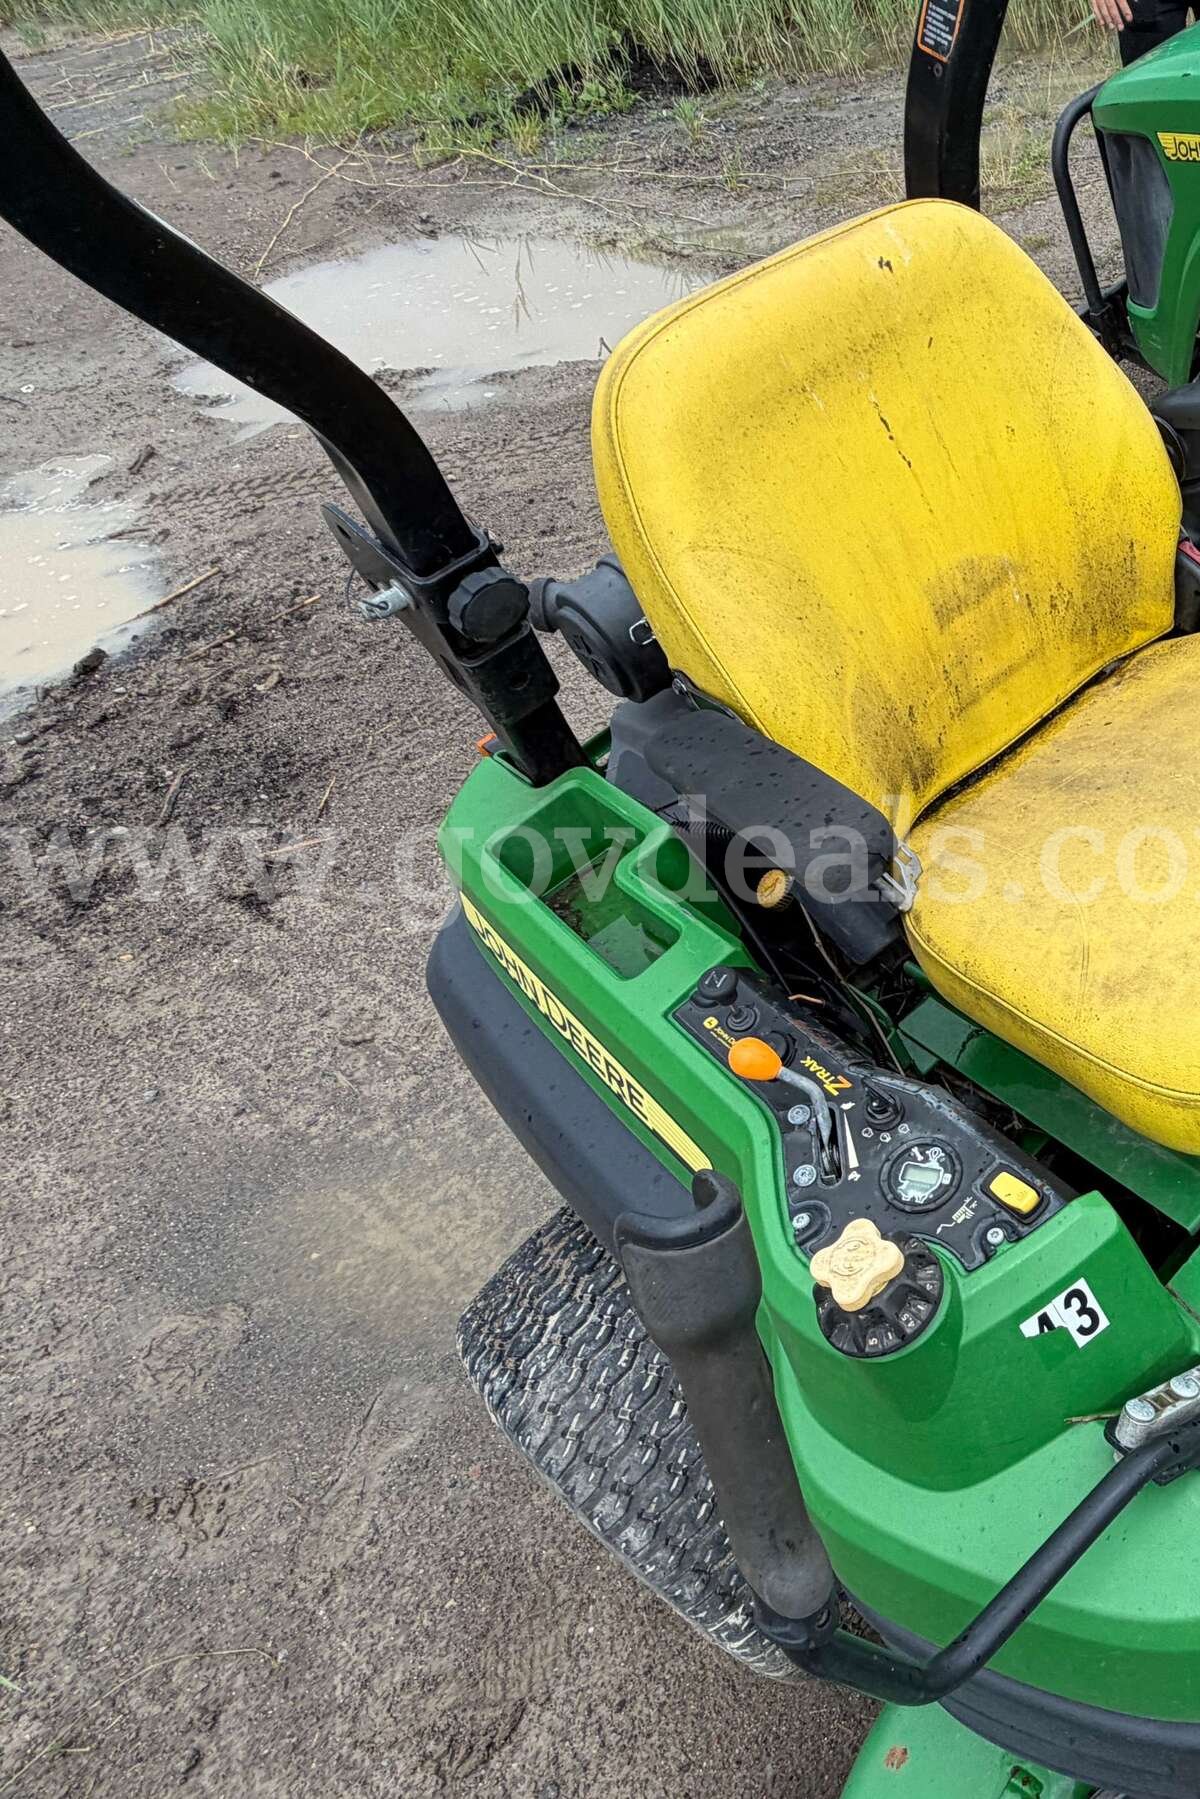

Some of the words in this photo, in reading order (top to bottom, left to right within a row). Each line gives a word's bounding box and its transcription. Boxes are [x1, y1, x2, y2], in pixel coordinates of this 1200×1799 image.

[475, 912, 542, 1012] JOHN
[542, 987, 650, 1122] DEERE
[901, 1312, 916, 1328] 4.5
